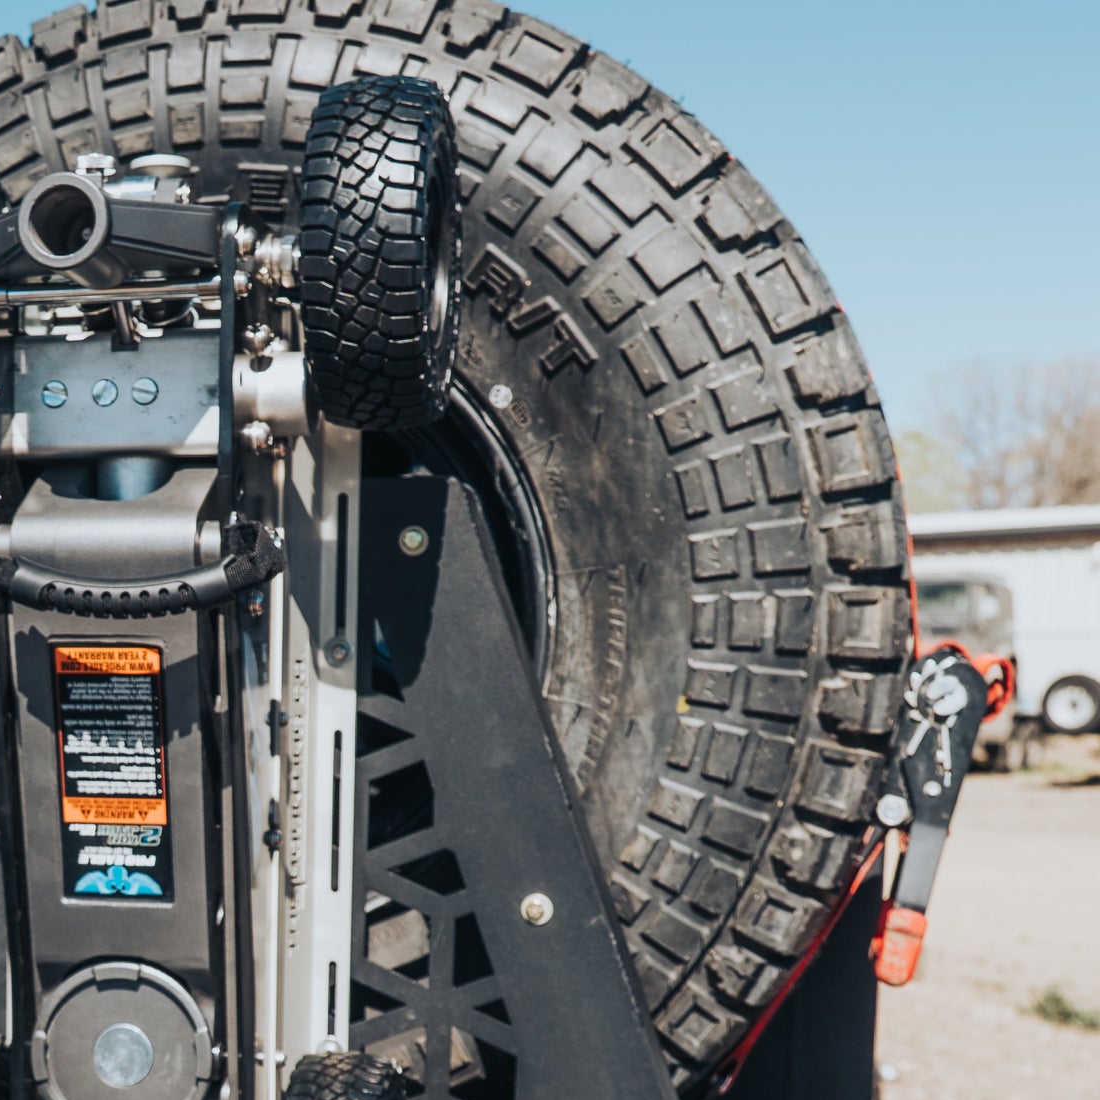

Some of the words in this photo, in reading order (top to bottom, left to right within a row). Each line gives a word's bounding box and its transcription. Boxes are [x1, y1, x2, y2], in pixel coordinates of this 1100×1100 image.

[67, 650, 116, 660] WARRANTY
[118, 651, 139, 660] YEAR
[95, 809, 136, 821] WARNING
[139, 826, 162, 847] 2
